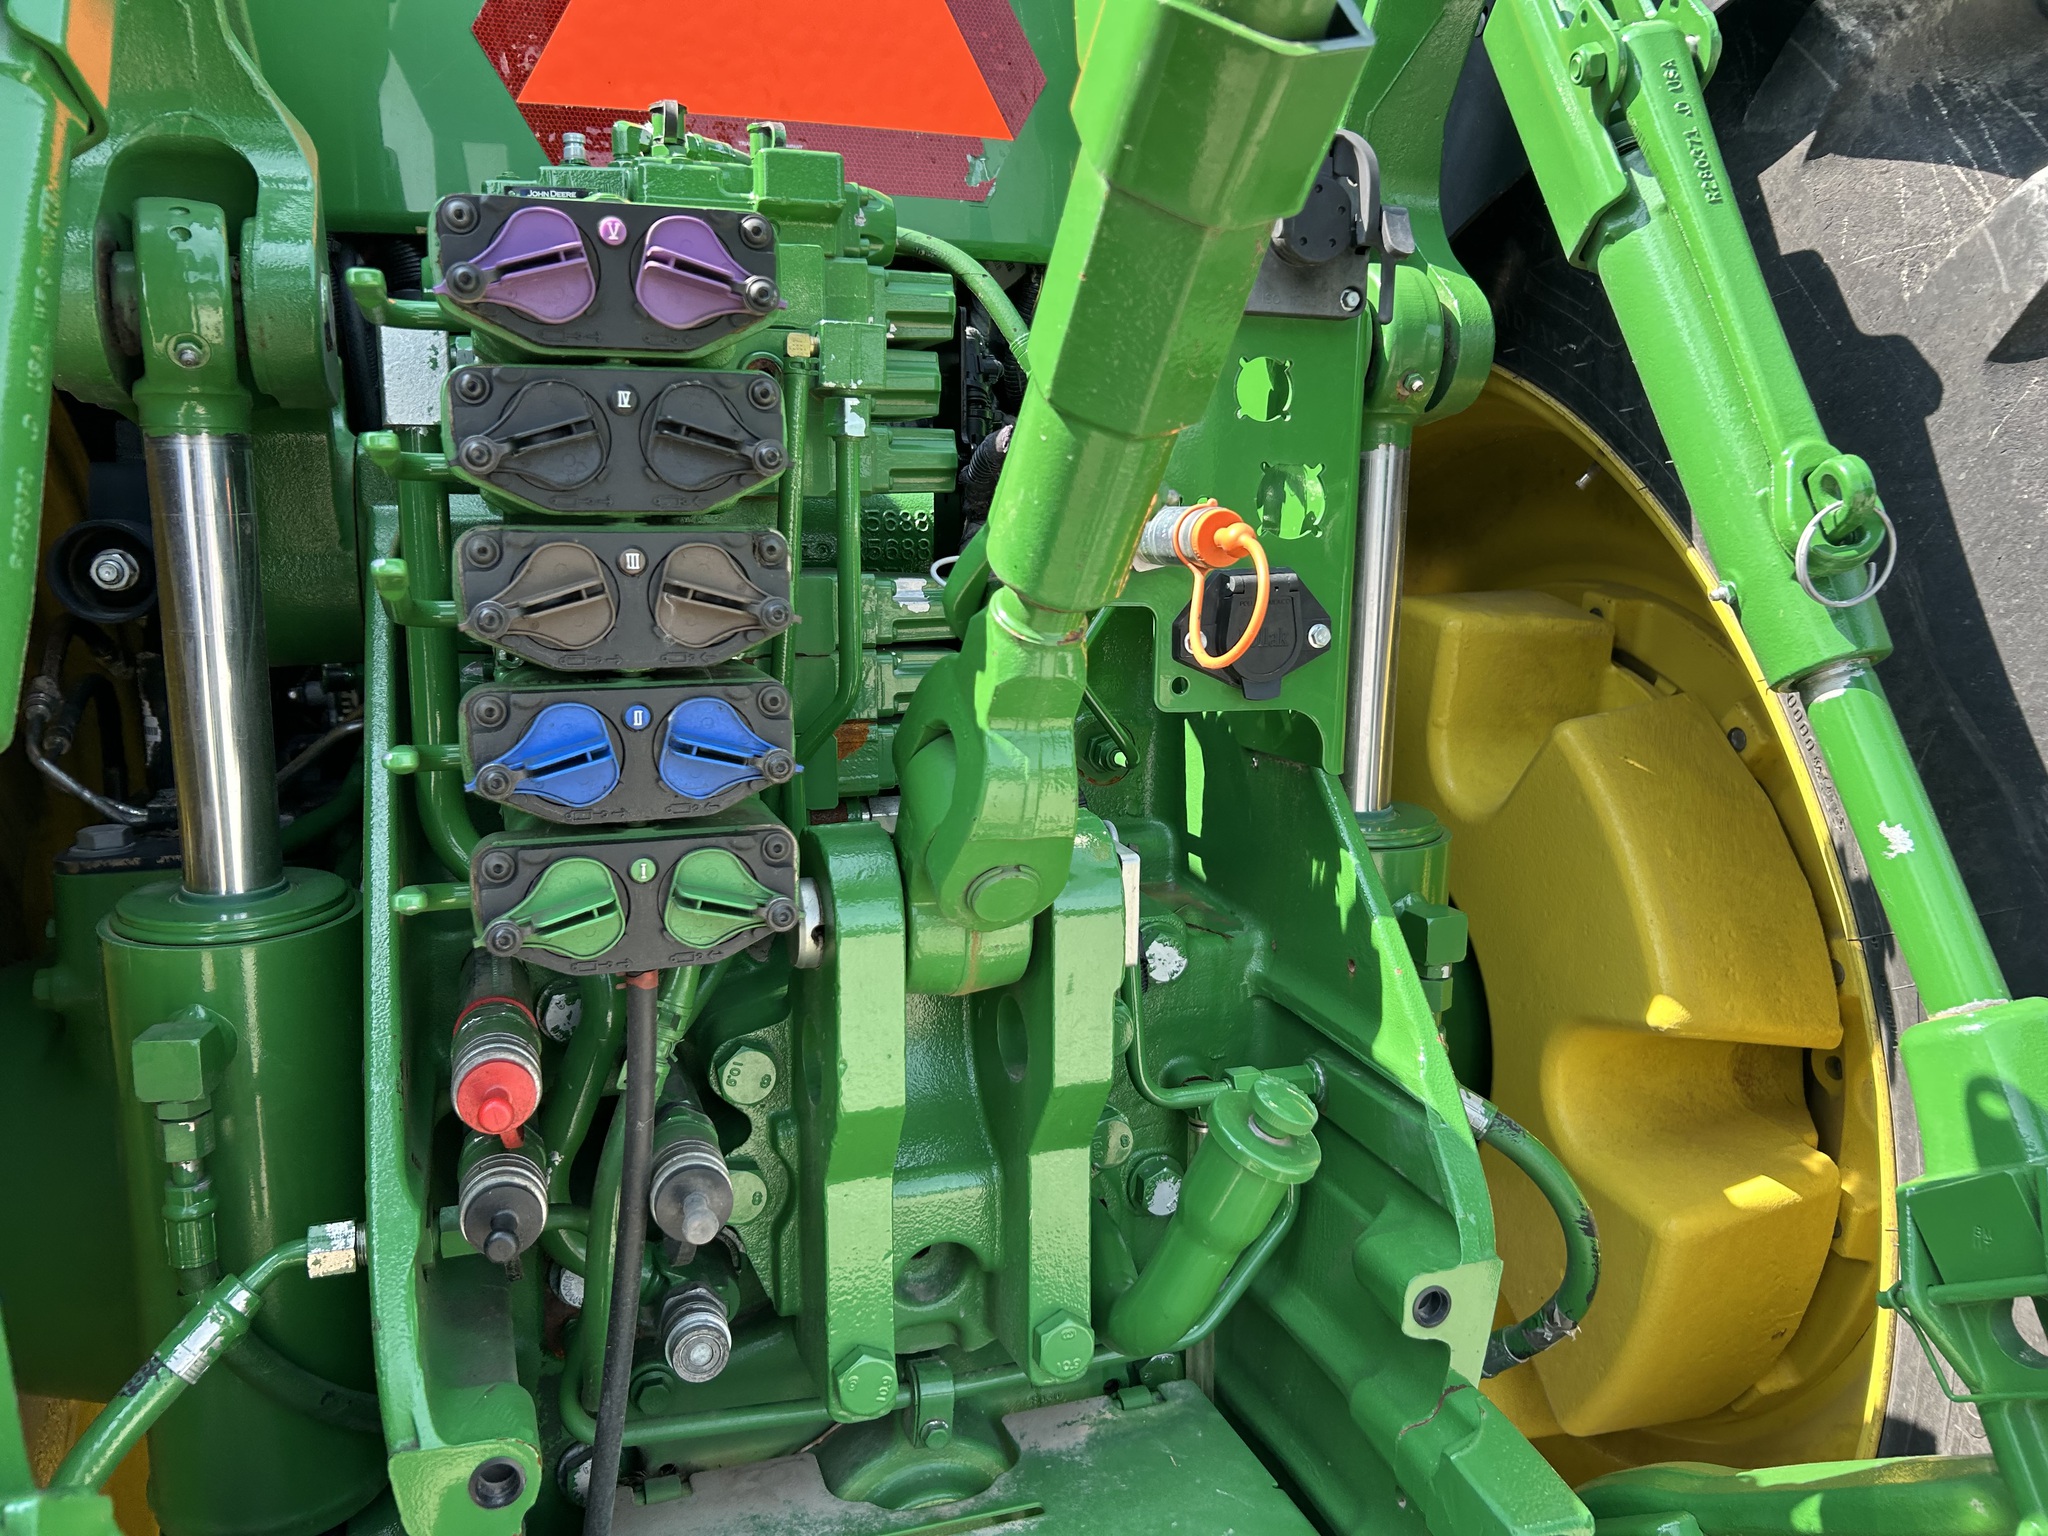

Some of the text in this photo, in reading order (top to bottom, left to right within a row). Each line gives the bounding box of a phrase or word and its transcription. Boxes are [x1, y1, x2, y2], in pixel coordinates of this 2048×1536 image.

[1660, 58, 1684, 93] USA
[527, 189, 577, 198] JOHN DEERE
[606, 221, 621, 240] V
[617, 390, 632, 408] IV
[860, 508, 935, 532] 5688
[625, 552, 641, 570] III
[633, 709, 644, 726] II
[640, 863, 647, 879] I
